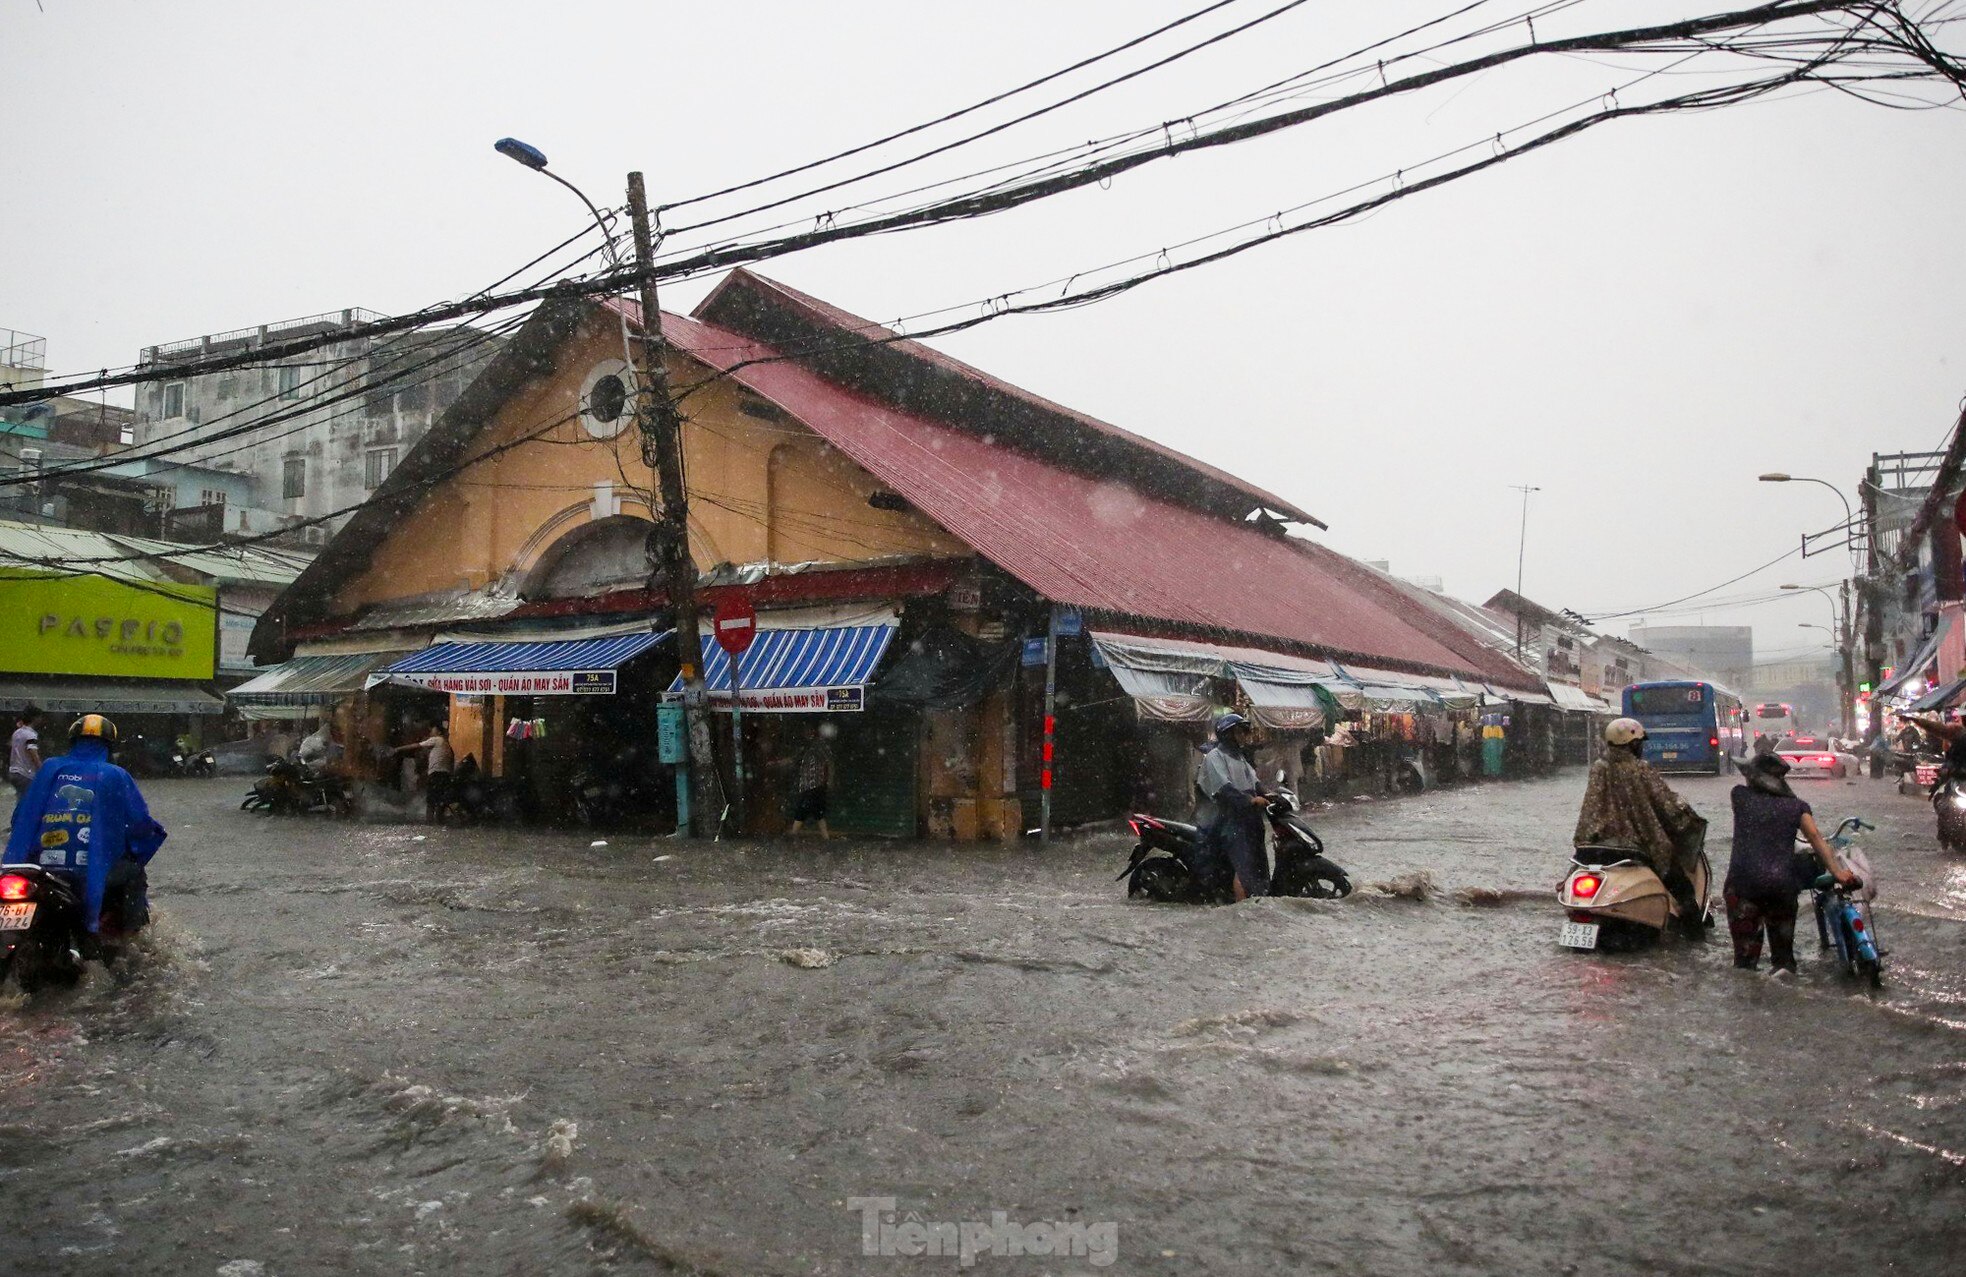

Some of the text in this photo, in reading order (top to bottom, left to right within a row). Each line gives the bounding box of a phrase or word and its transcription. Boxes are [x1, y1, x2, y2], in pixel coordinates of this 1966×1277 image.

[444, 677, 463, 691] HÀNG
[534, 678, 551, 691] MAY
[794, 695, 809, 708] MAY
